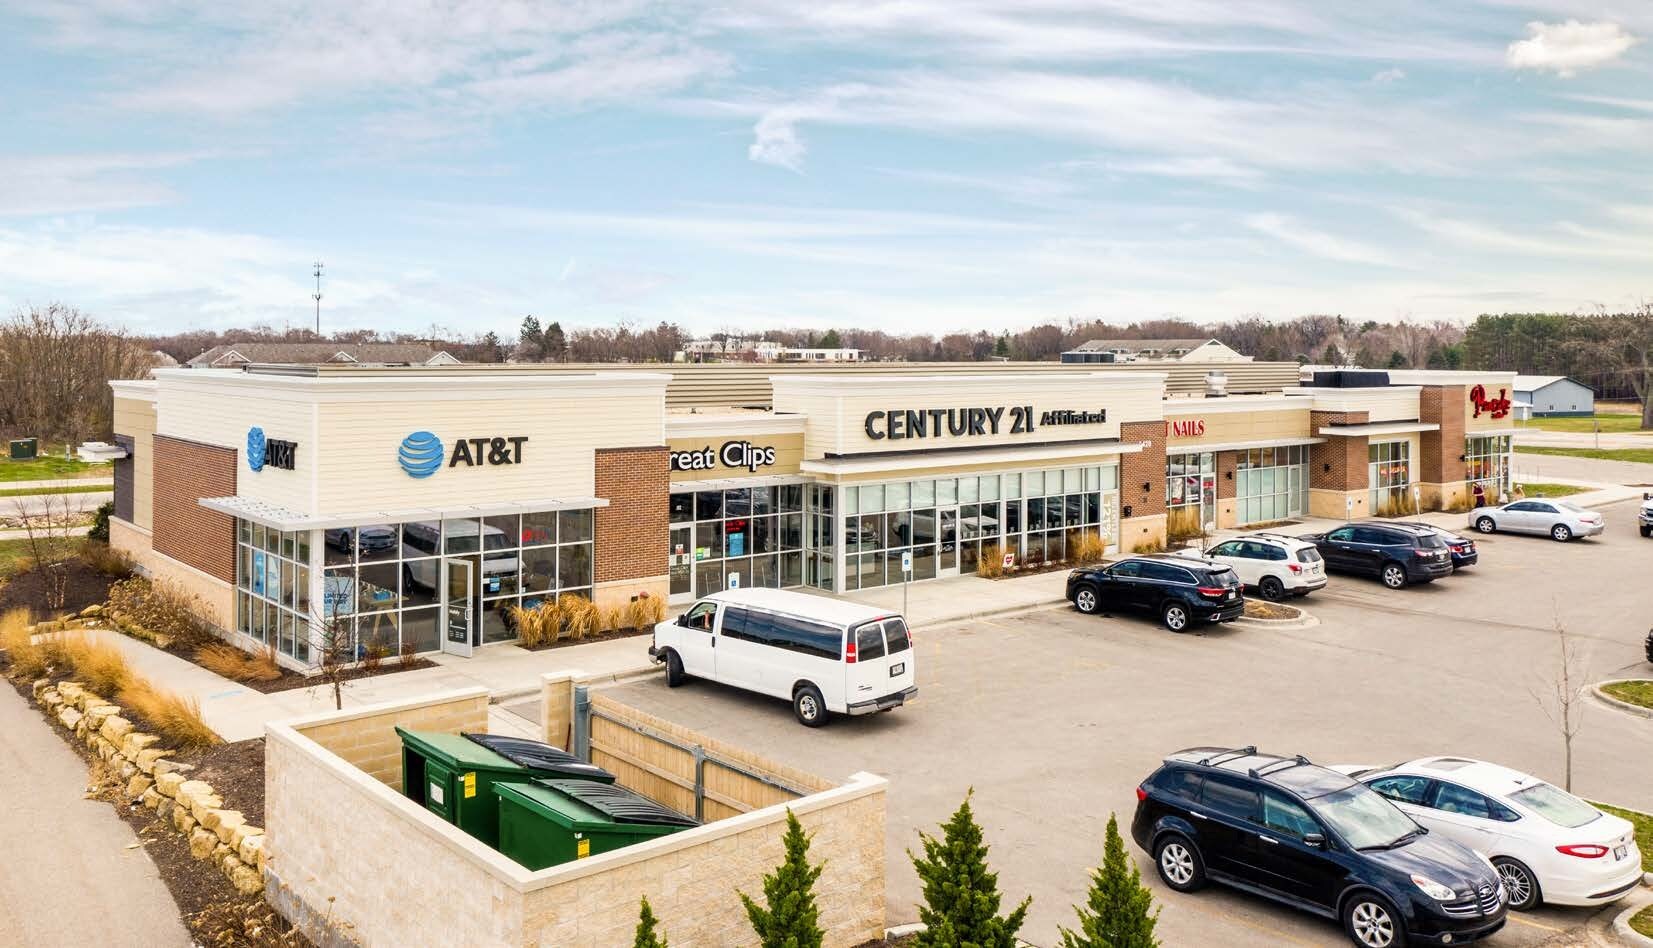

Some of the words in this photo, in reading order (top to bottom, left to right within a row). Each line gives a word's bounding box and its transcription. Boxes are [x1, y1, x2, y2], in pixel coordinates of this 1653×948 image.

[865, 407, 1005, 440] CENTURY
[1010, 406, 1034, 433] 21
[1040, 409, 1106, 425] Affiliated
[1173, 420, 1204, 435] NAILS
[449, 436, 529, 467] AT&T
[669, 445, 715, 471] reat
[720, 440, 776, 472] Clips
